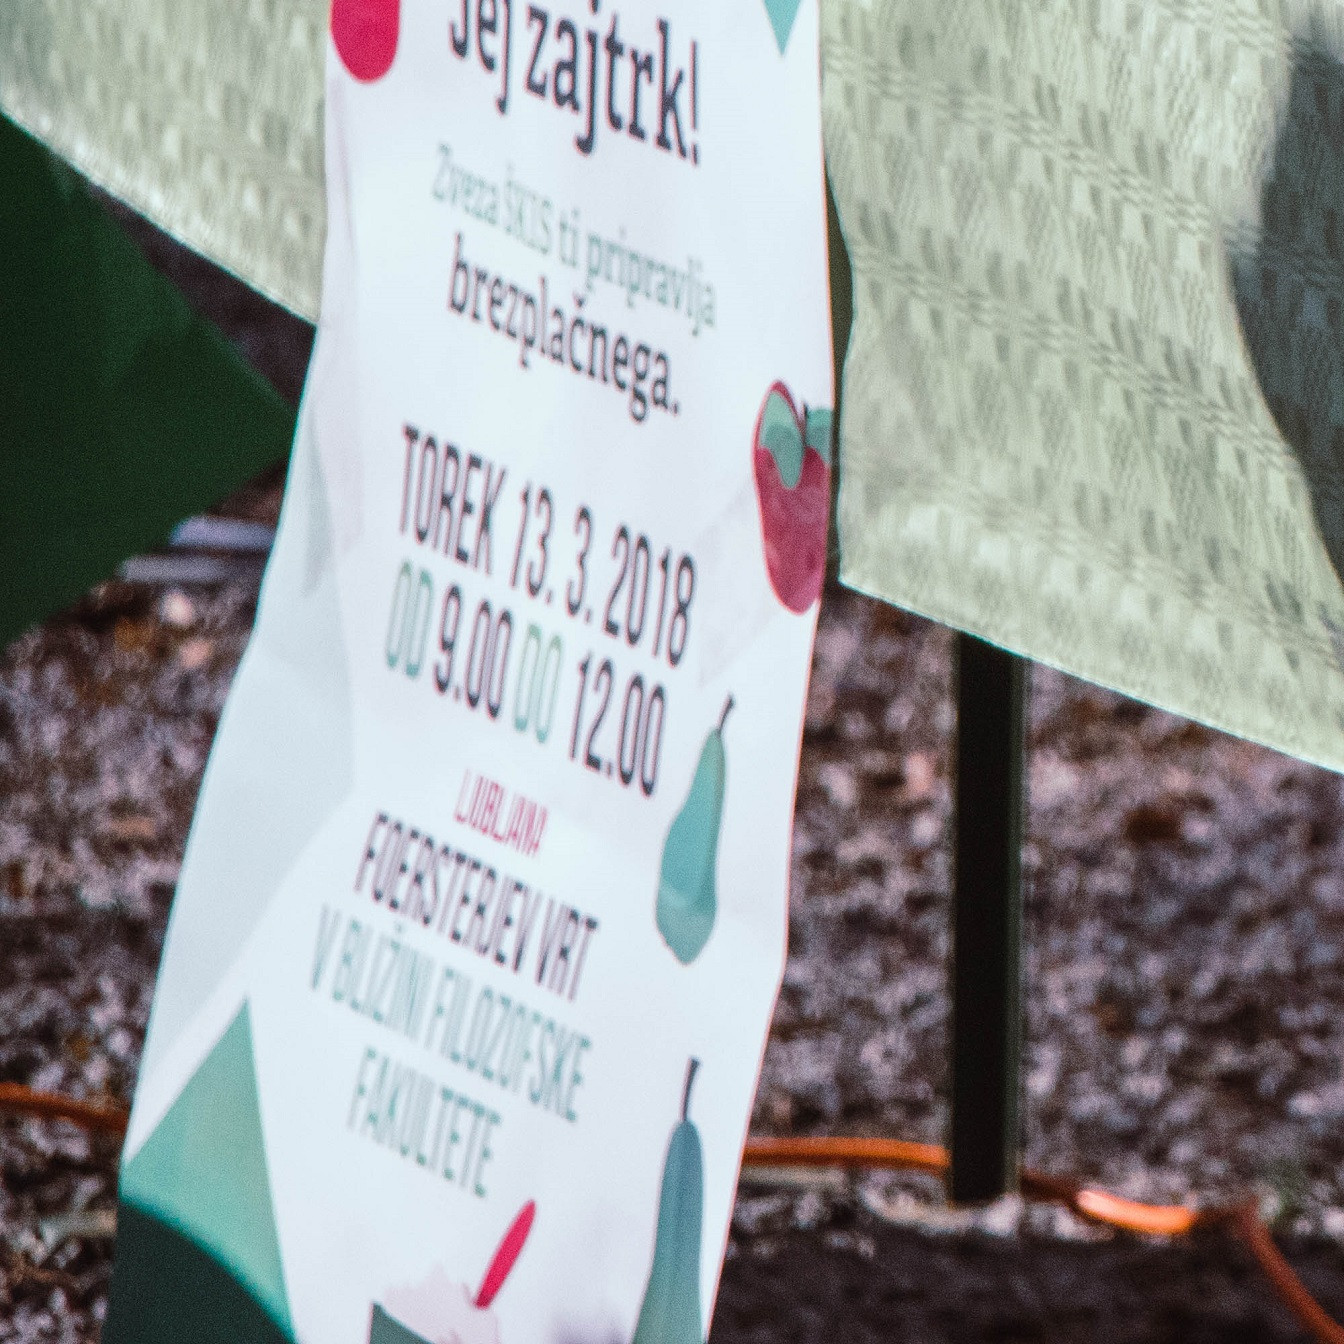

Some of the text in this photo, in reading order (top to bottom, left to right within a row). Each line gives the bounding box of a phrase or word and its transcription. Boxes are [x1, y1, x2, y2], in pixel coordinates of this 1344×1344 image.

[431, 145, 717, 338] Zveza ŠKIS ti pripravlja
[448, 233, 681, 425] brezplačnega.
[400, 423, 697, 668] TOREK 13. 3. 2018
[386, 561, 435, 679] OD
[433, 583, 515, 721] 9.00
[568, 656, 667, 798] 12.00
